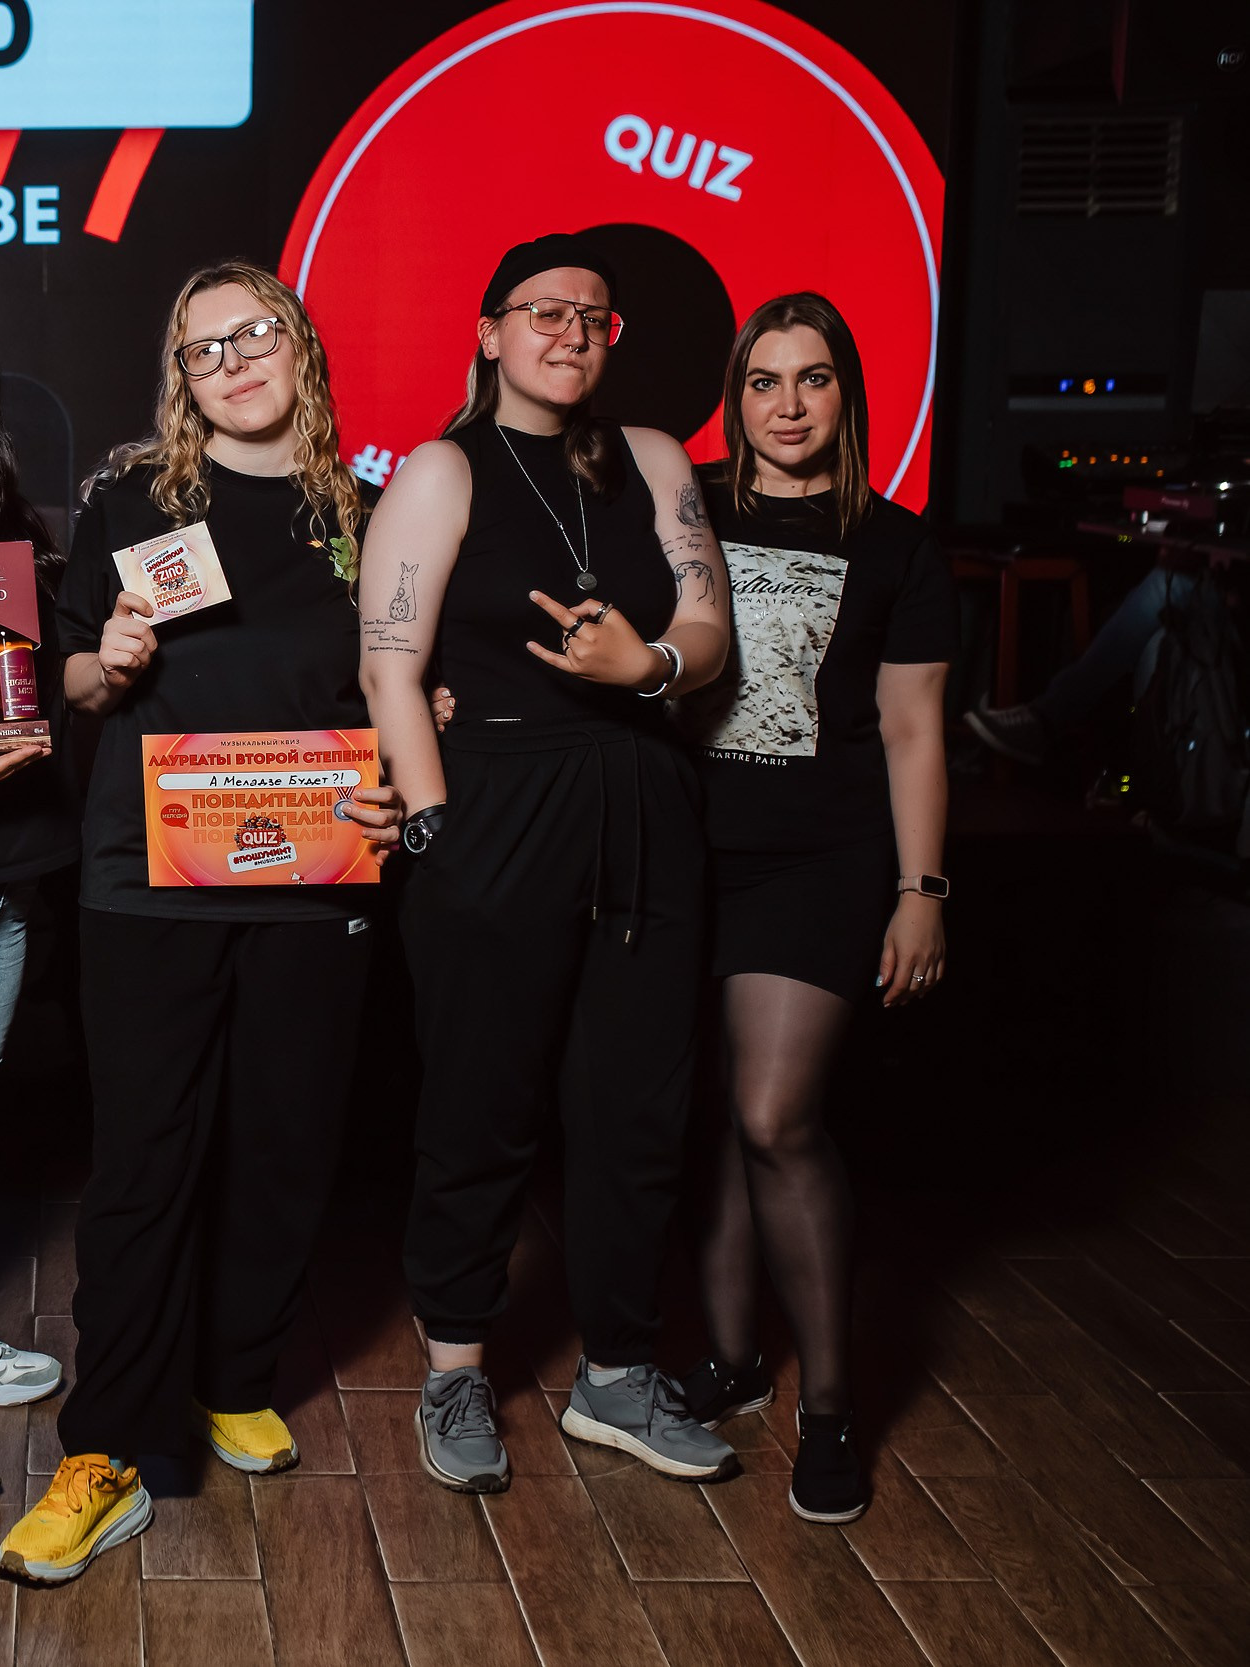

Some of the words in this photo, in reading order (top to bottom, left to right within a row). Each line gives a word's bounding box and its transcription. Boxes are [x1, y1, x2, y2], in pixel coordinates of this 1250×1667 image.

[604, 114, 754, 202] QUIZ
[158, 565, 184, 581] QUIZ
[731, 572, 823, 597] clusive
[220, 738, 278, 747] МУЗЫКАЛЬНЫЙ
[148, 752, 231, 767] ЛАУРЕАТЫ
[235, 749, 299, 765] ВТОРОЙ
[302, 749, 374, 764] СТЕПЕНИ
[706, 750, 751, 762] MARTRE
[755, 755, 788, 767] PARIS
[209, 775, 217, 787] А
[223, 775, 282, 787] Меладзе
[288, 775, 329, 786] Будет
[192, 791, 333, 809] ПОБЕДИТЕЛИ!
[193, 810, 333, 827] ПОБЕТЕЛИ!
[242, 831, 278, 845] QUIZ
